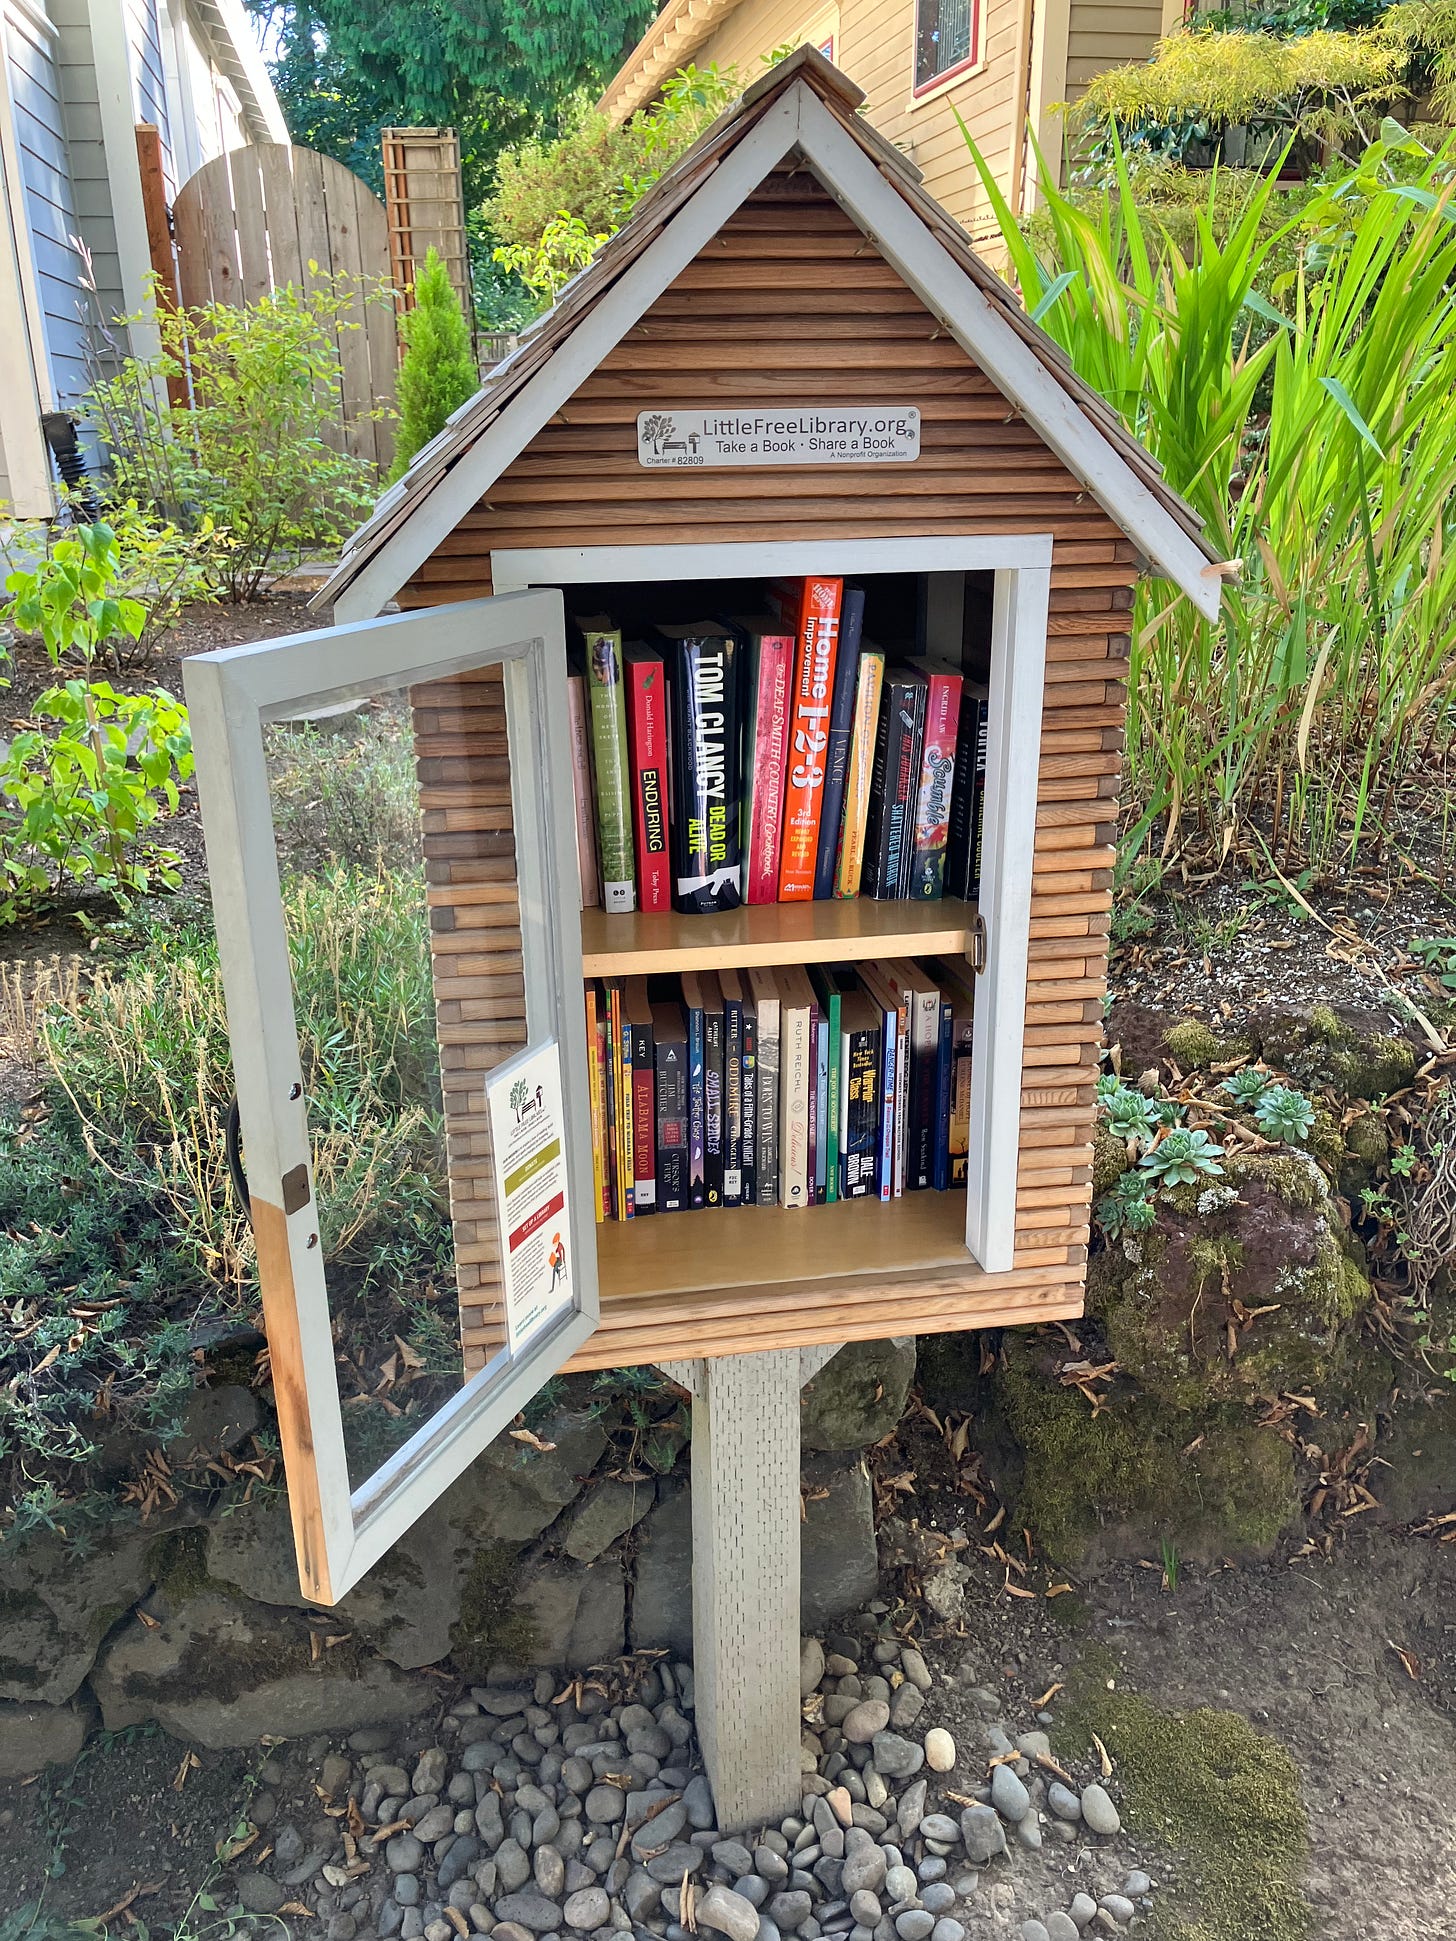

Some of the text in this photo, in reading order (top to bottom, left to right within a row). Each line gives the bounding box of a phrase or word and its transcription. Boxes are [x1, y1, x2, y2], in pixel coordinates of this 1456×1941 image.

[703, 416, 907, 437] LittleFreeLibrary.org
[716, 436, 896, 453] Take a Book Share a Book
[677, 456, 704, 465] 82809
[837, 450, 866, 459] Nonprofit
[867, 449, 908, 458] Organization
[801, 616, 817, 697] Improvement
[811, 616, 839, 699] Home
[774, 679, 786, 715] DEAF
[938, 685, 950, 734] INGRID LAW
[645, 695, 654, 758] Donald Harington
[694, 652, 726, 799] TOM CLANCY
[770, 714, 785, 760] SMITH
[792, 703, 830, 788] 1-2-3
[831, 739, 848, 785] VENICE
[767, 760, 780, 822] COUNTRY
[926, 752, 952, 826] Scumble
[643, 770, 662, 851] ENDURING
[790, 817, 816, 825] Edition
[797, 808, 811, 817] 3rd
[688, 817, 706, 855] ALIVE
[709, 805, 726, 862] DEAD OR
[761, 822, 777, 880] Cookbook
[848, 831, 858, 855] PEARL
[884, 804, 904, 888] SHATTERED MIRROR
[651, 869, 659, 886] Toby
[847, 864, 856, 885] BUCK
[730, 1010, 738, 1039] RITTER
[638, 1039, 646, 1058] KEY
[794, 1020, 803, 1093] RUTH REICHL
[659, 1070, 668, 1113] BUTCHER
[667, 1083, 676, 1098] JIM
[728, 1057, 740, 1117] ODDMIRE
[743, 1073, 754, 1089] Tales
[762, 1076, 773, 1103] BORN
[850, 1077, 861, 1101] Class
[862, 1069, 877, 1103] Warrior
[637, 1085, 649, 1174] ALABAMA MOON
[705, 1069, 721, 1156] SMALL SPACES
[743, 1103, 754, 1139] Fifth-Grade
[761, 1105, 773, 1120] TO
[761, 1121, 773, 1143] WIN
[790, 1120, 805, 1176] Delicious!
[742, 1139, 754, 1167] KNIGHT
[847, 1153, 860, 1185] BROWN
[860, 1156, 874, 1178] DALE
[663, 1162, 673, 1185] FURY
[671, 1153, 681, 1193] CURSOR'S
